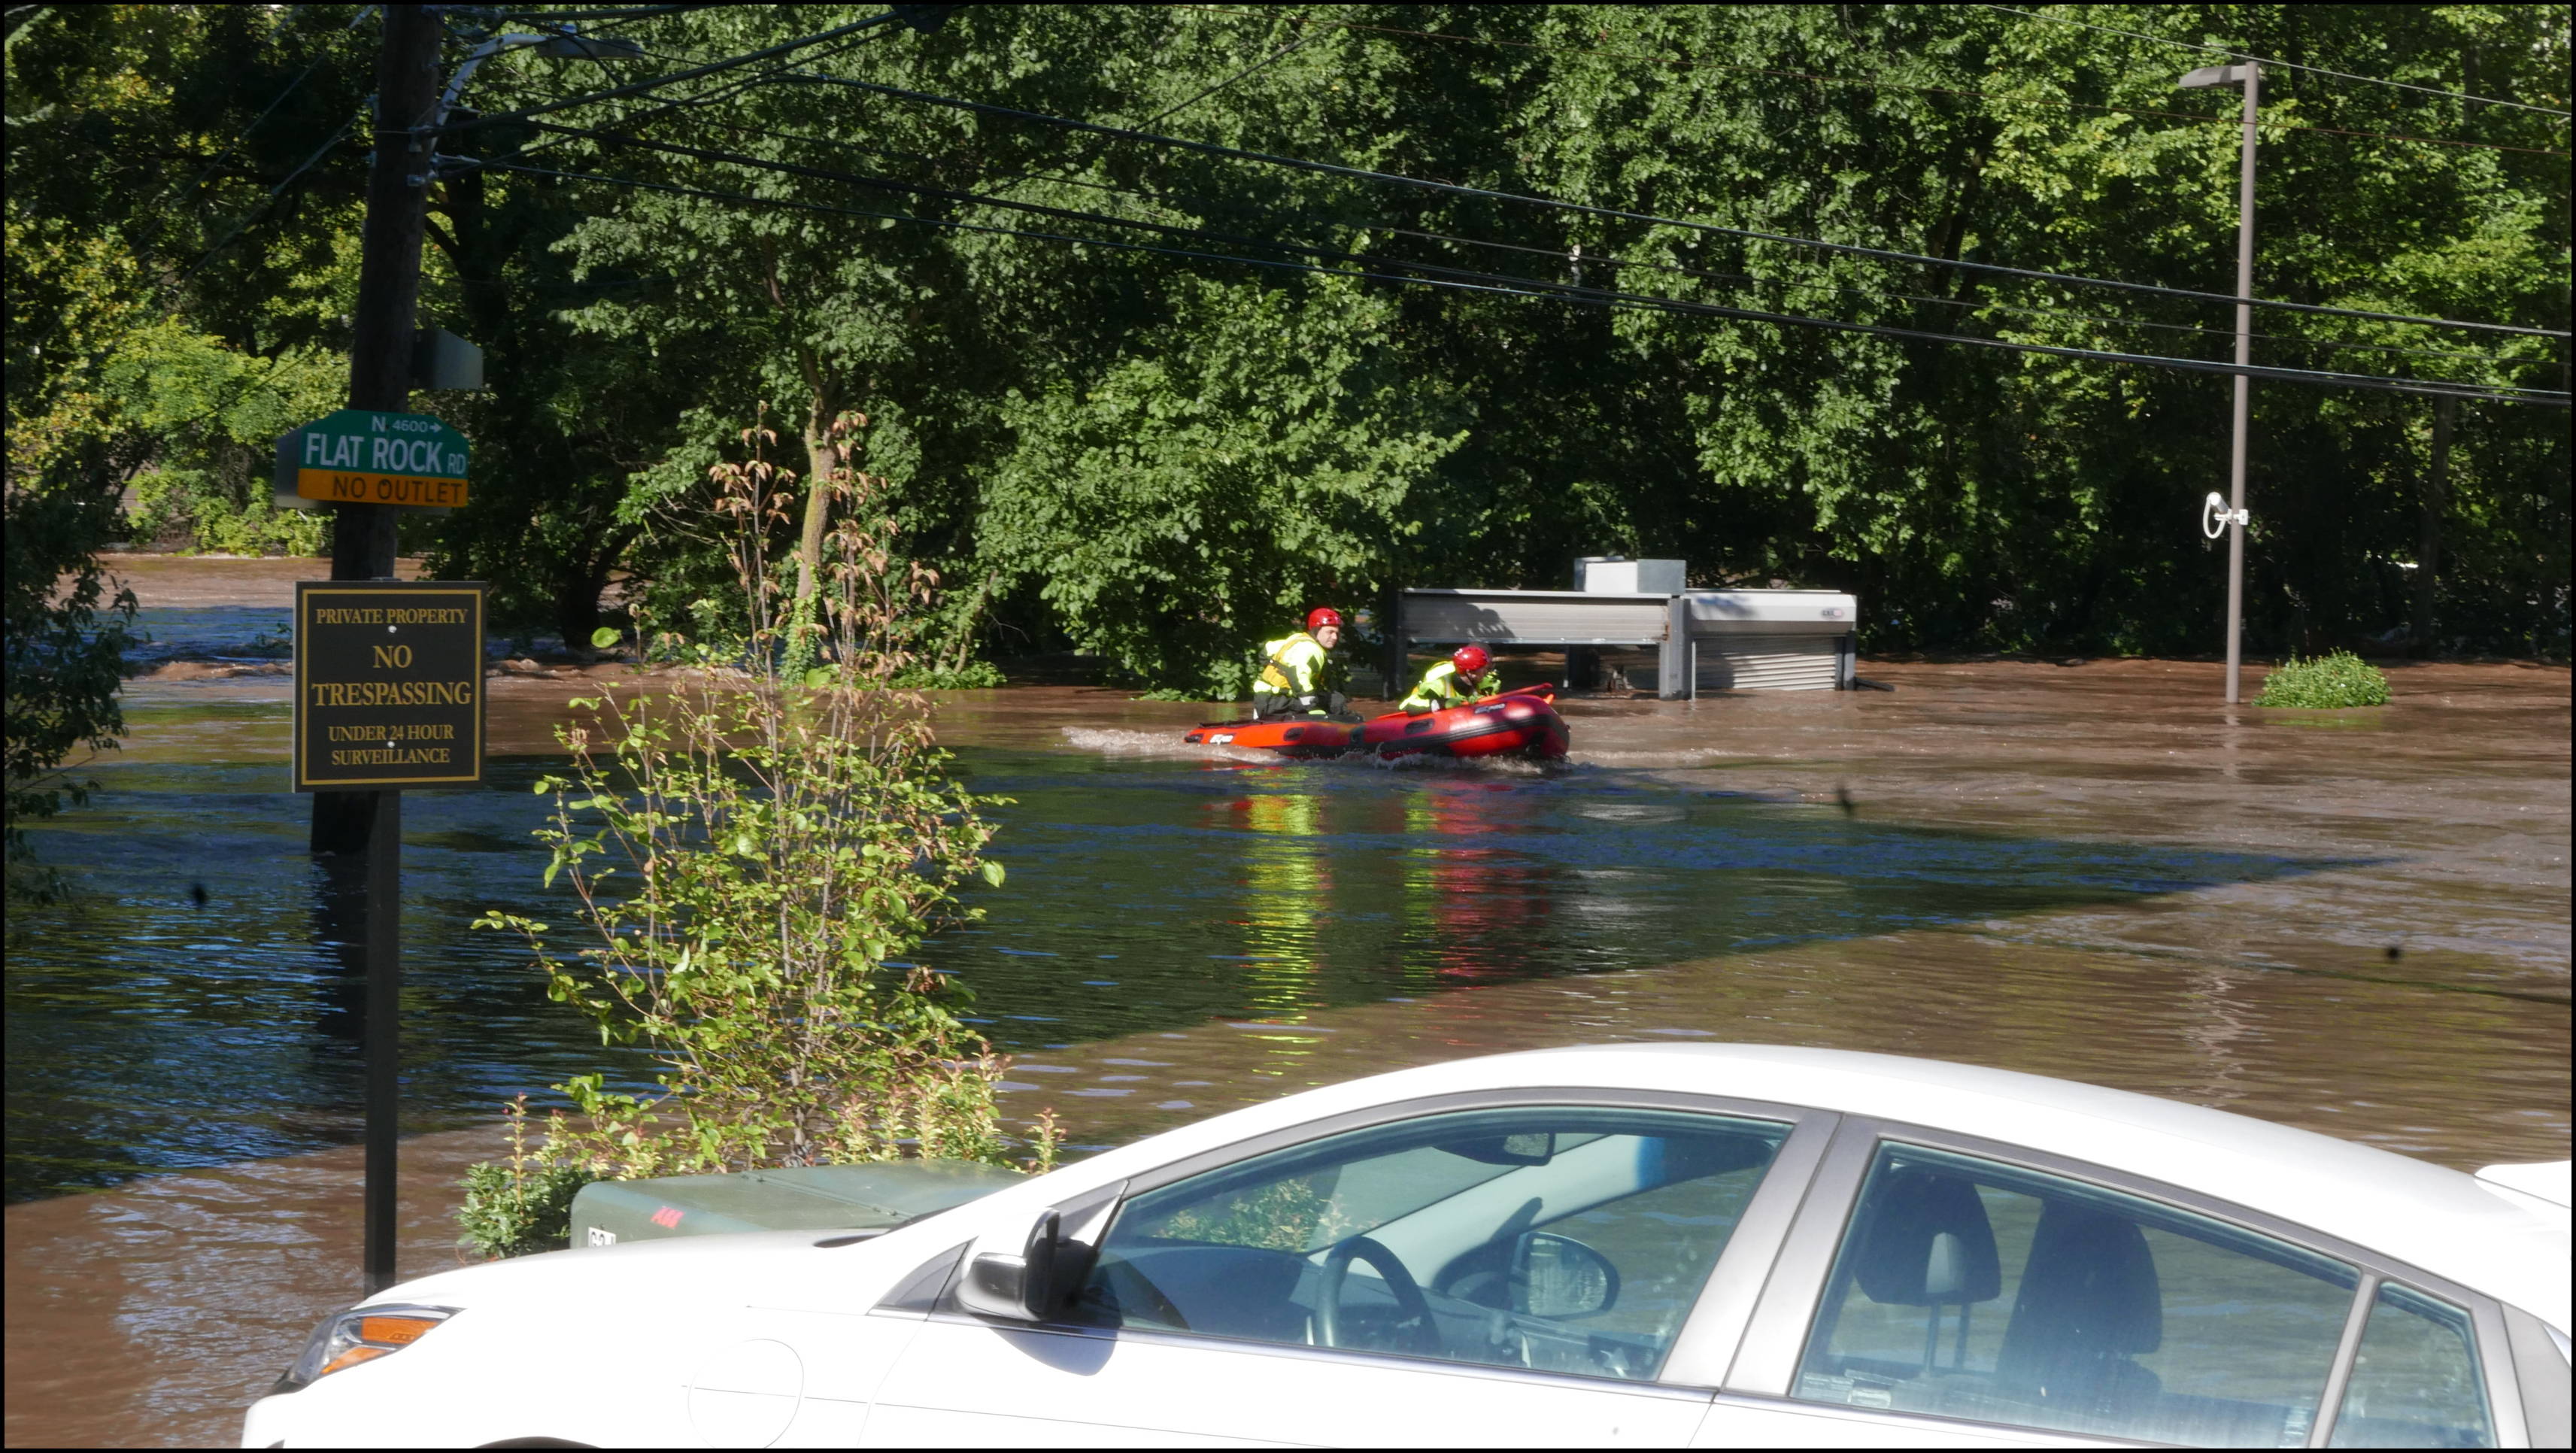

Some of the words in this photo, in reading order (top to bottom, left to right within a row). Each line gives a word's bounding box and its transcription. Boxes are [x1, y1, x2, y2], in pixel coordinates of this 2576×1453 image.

[371, 415, 387, 432] N
[392, 420, 429, 433] 4600
[305, 432, 365, 468] FLAT
[372, 437, 443, 474] ROCK
[447, 453, 466, 475] RD
[332, 476, 366, 499] NO
[377, 479, 463, 503] OUTLET
[316, 608, 383, 624] PRIVATE
[386, 608, 469, 624] PROPERTY
[372, 645, 413, 669] NO
[311, 681, 472, 706] TRESPASSING
[329, 725, 387, 742] UNDER
[389, 725, 404, 740] 24
[407, 724, 455, 740] HOUR
[331, 748, 451, 766] SURVEILLANCE
